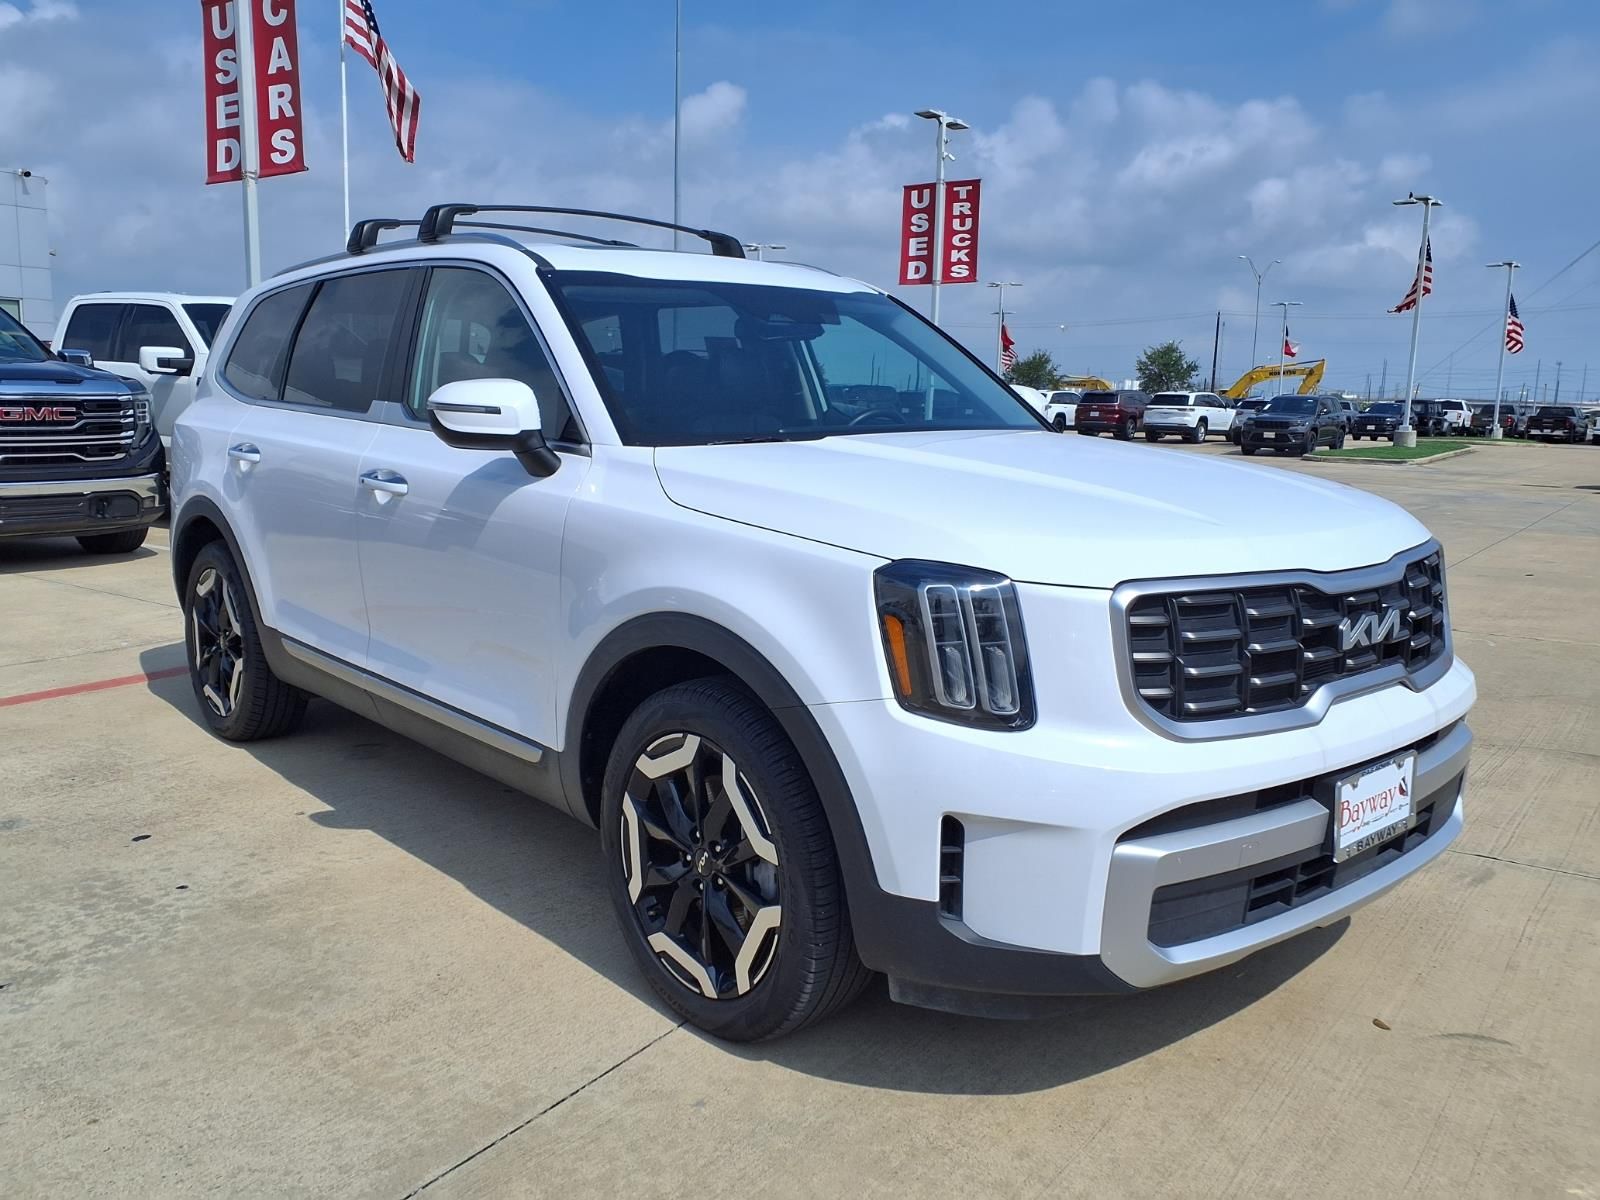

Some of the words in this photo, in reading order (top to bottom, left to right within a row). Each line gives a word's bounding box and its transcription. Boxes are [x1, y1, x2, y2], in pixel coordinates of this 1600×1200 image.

[211, 2, 241, 172] USED
[262, 0, 296, 165] CARS
[907, 188, 931, 280] USED
[950, 186, 973, 278] TRUCKS
[0, 406, 77, 421] GMC
[1340, 608, 1401, 651] KIA
[1340, 786, 1397, 829] Bayway
[1357, 824, 1398, 852] BAYWAY
